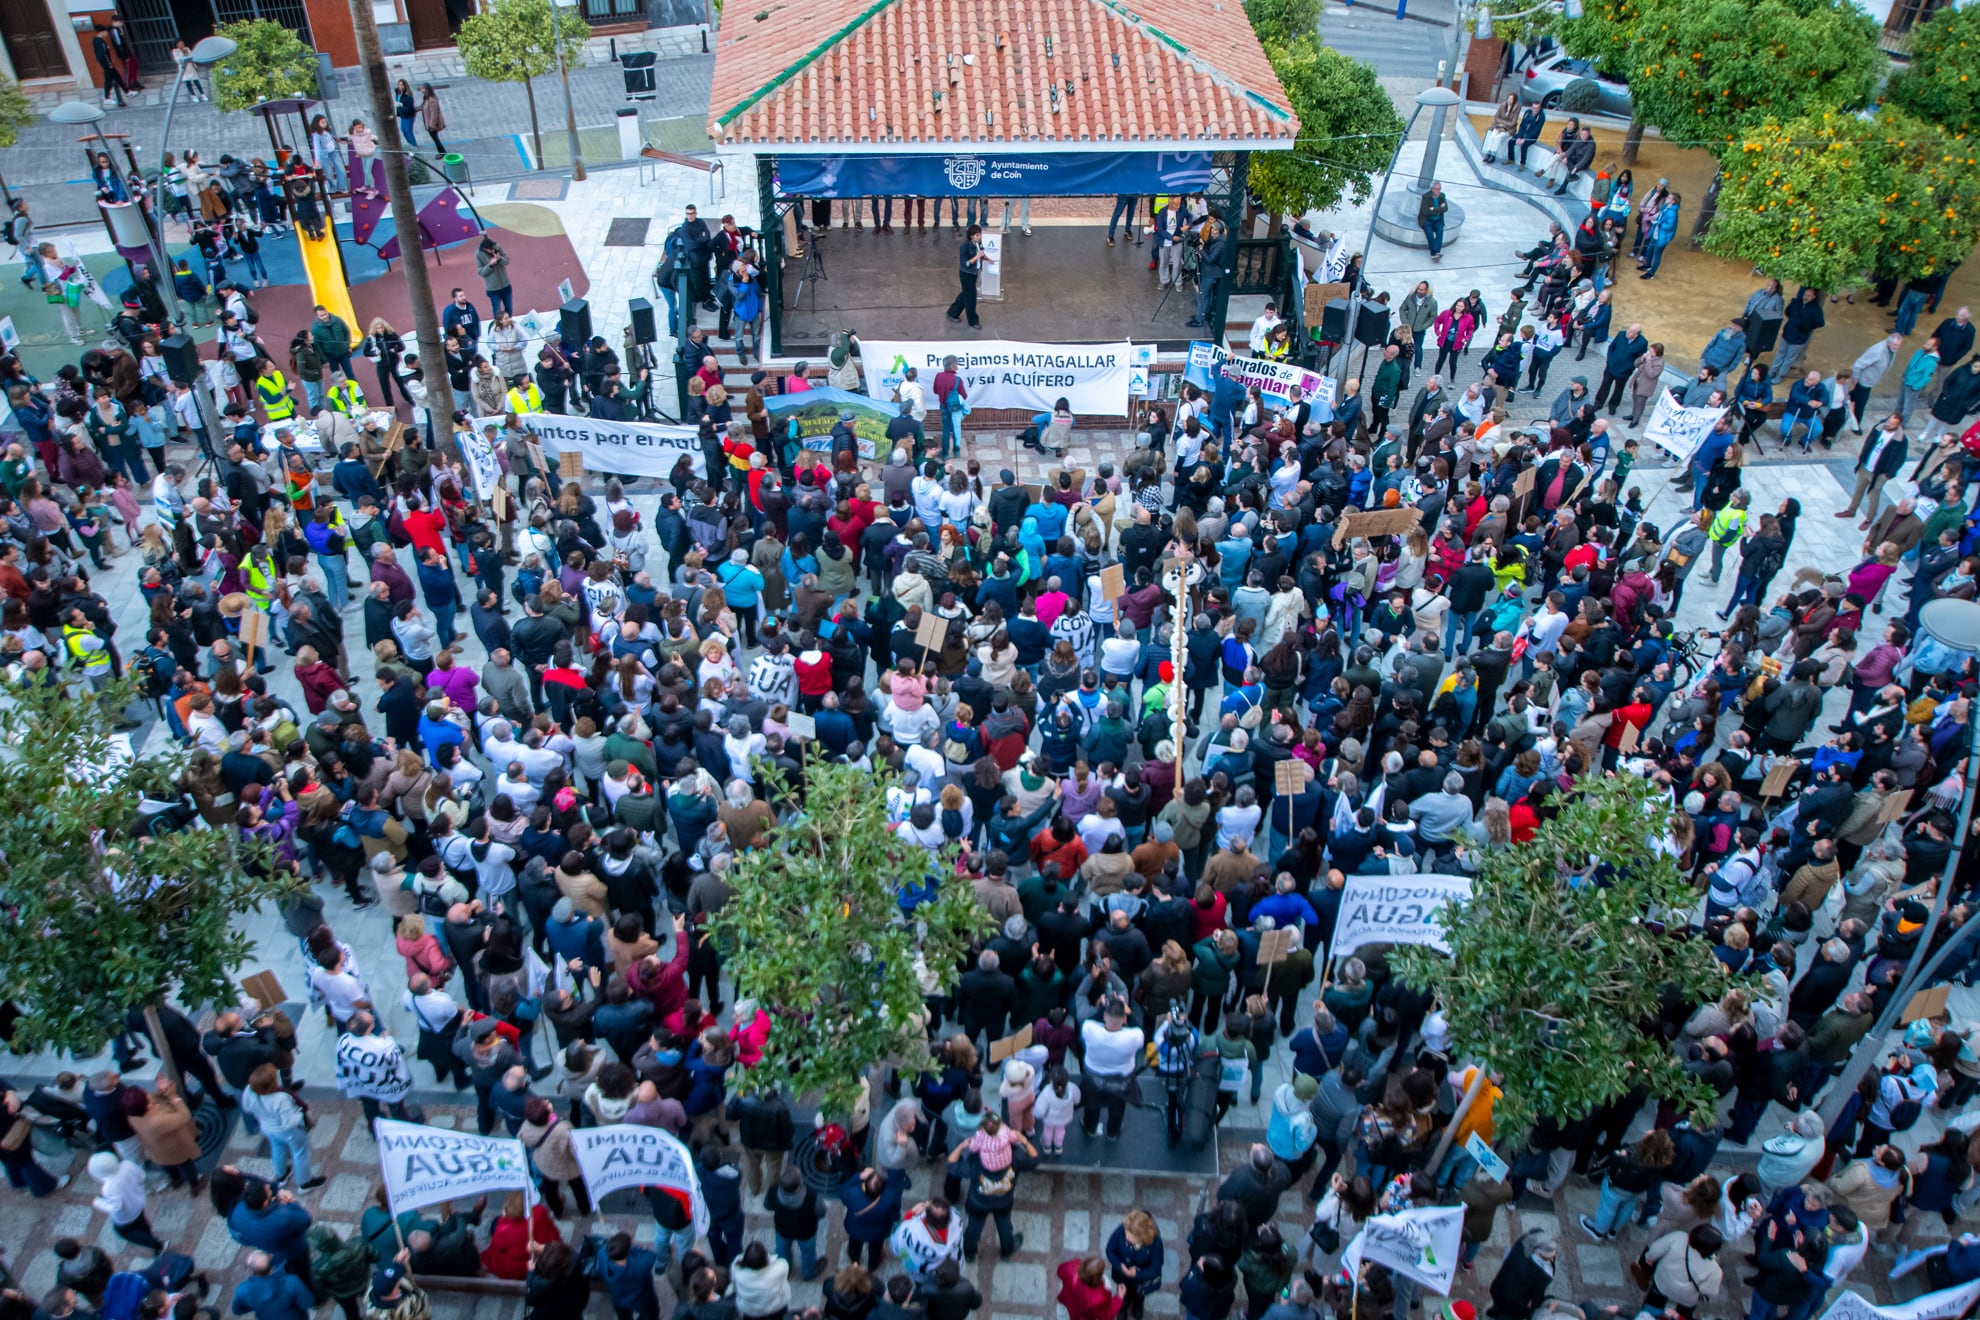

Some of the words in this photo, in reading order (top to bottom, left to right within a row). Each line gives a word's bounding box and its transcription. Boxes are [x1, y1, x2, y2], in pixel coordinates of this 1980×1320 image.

[991, 160, 1049, 171] Ayuntamiento
[991, 171, 1001, 179] de
[1003, 171, 1022, 179] Coín
[927, 353, 1009, 370] Prejamos
[1013, 353, 1116, 369] MATAGALLAR
[968, 375, 976, 386] y
[979, 375, 995, 385] su
[1002, 372, 1075, 387] ACUÍFERO
[1279, 370, 1293, 380] de
[596, 432, 630, 446] por
